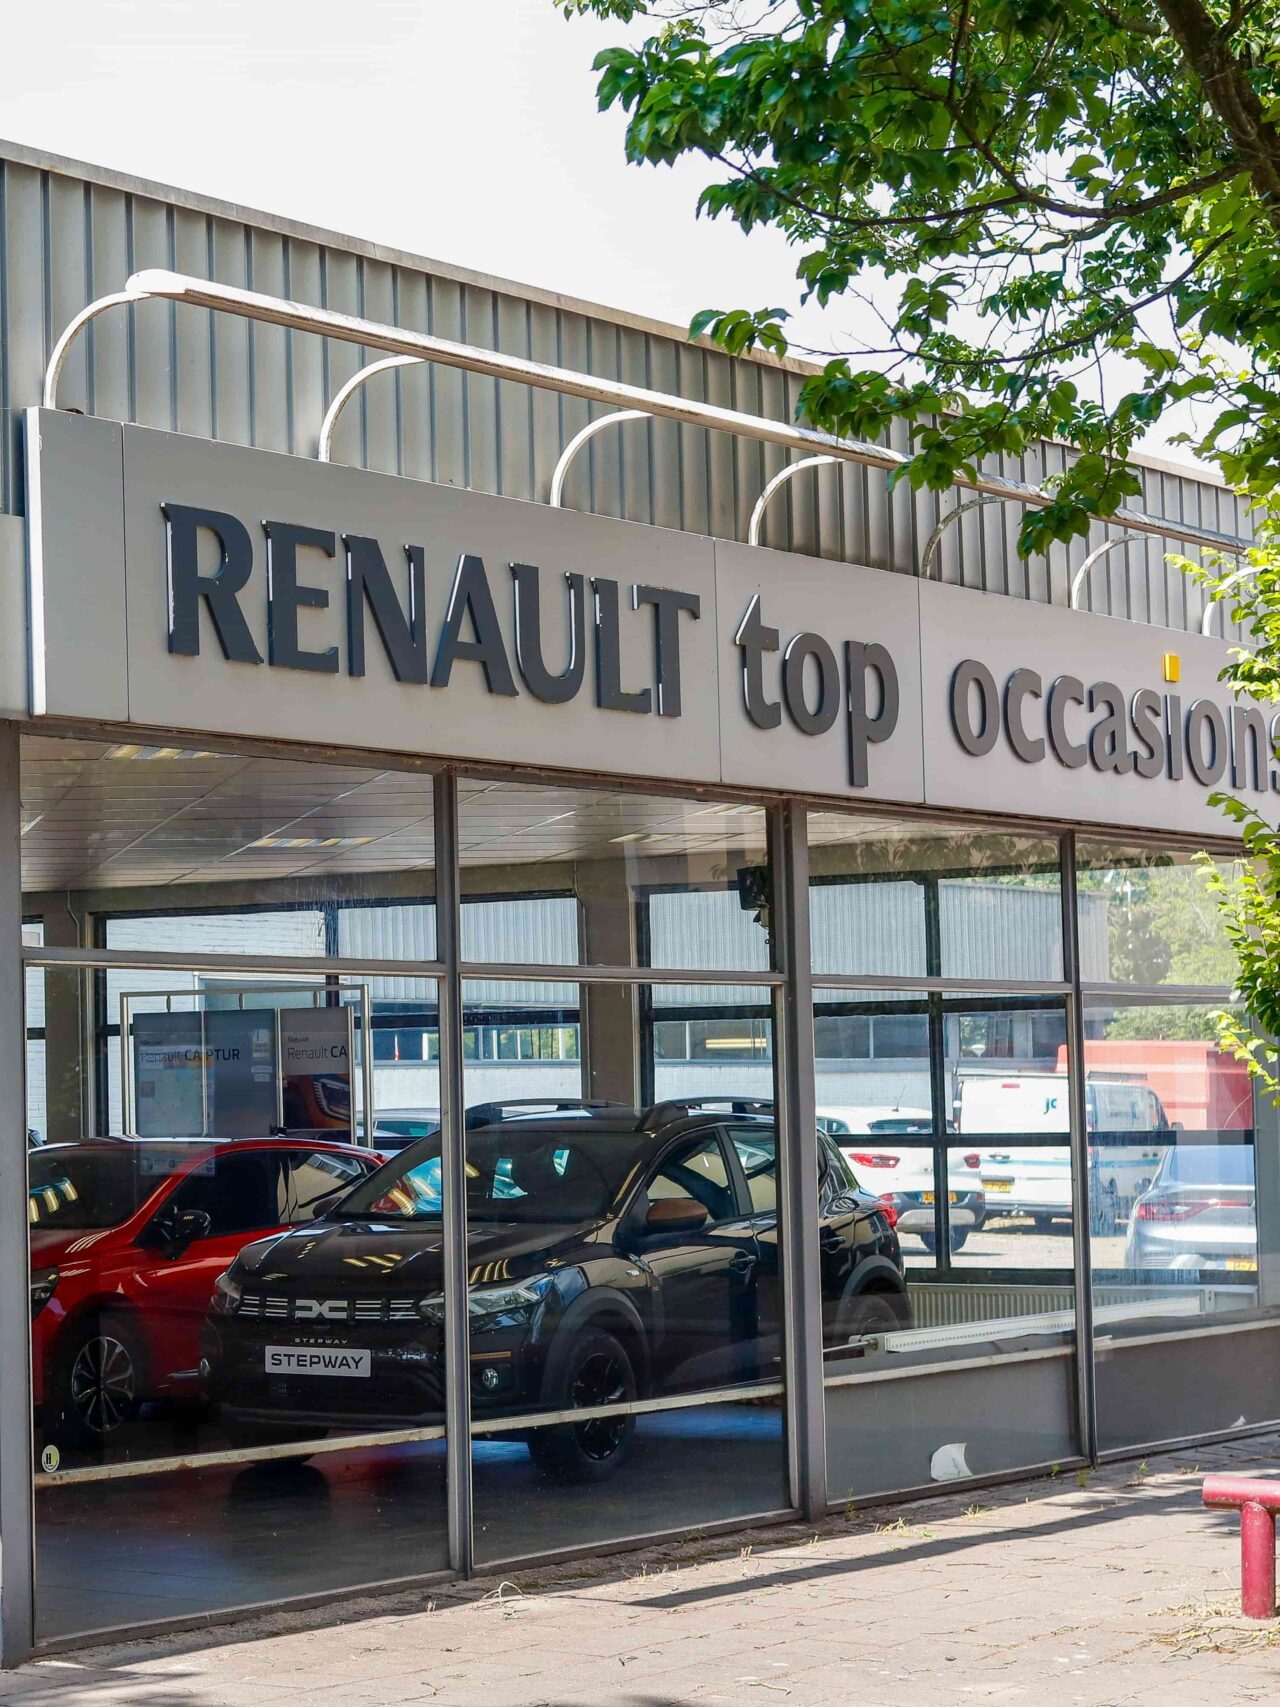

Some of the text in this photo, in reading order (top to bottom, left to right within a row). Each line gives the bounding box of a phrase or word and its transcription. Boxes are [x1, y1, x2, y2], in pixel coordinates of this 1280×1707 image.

[161, 502, 700, 717] RENAULT
[734, 594, 900, 787] top
[288, 1046, 328, 1060] Renault
[294, 1337, 348, 1345] STEPWAY
[271, 1352, 364, 1370] STEPWAY
